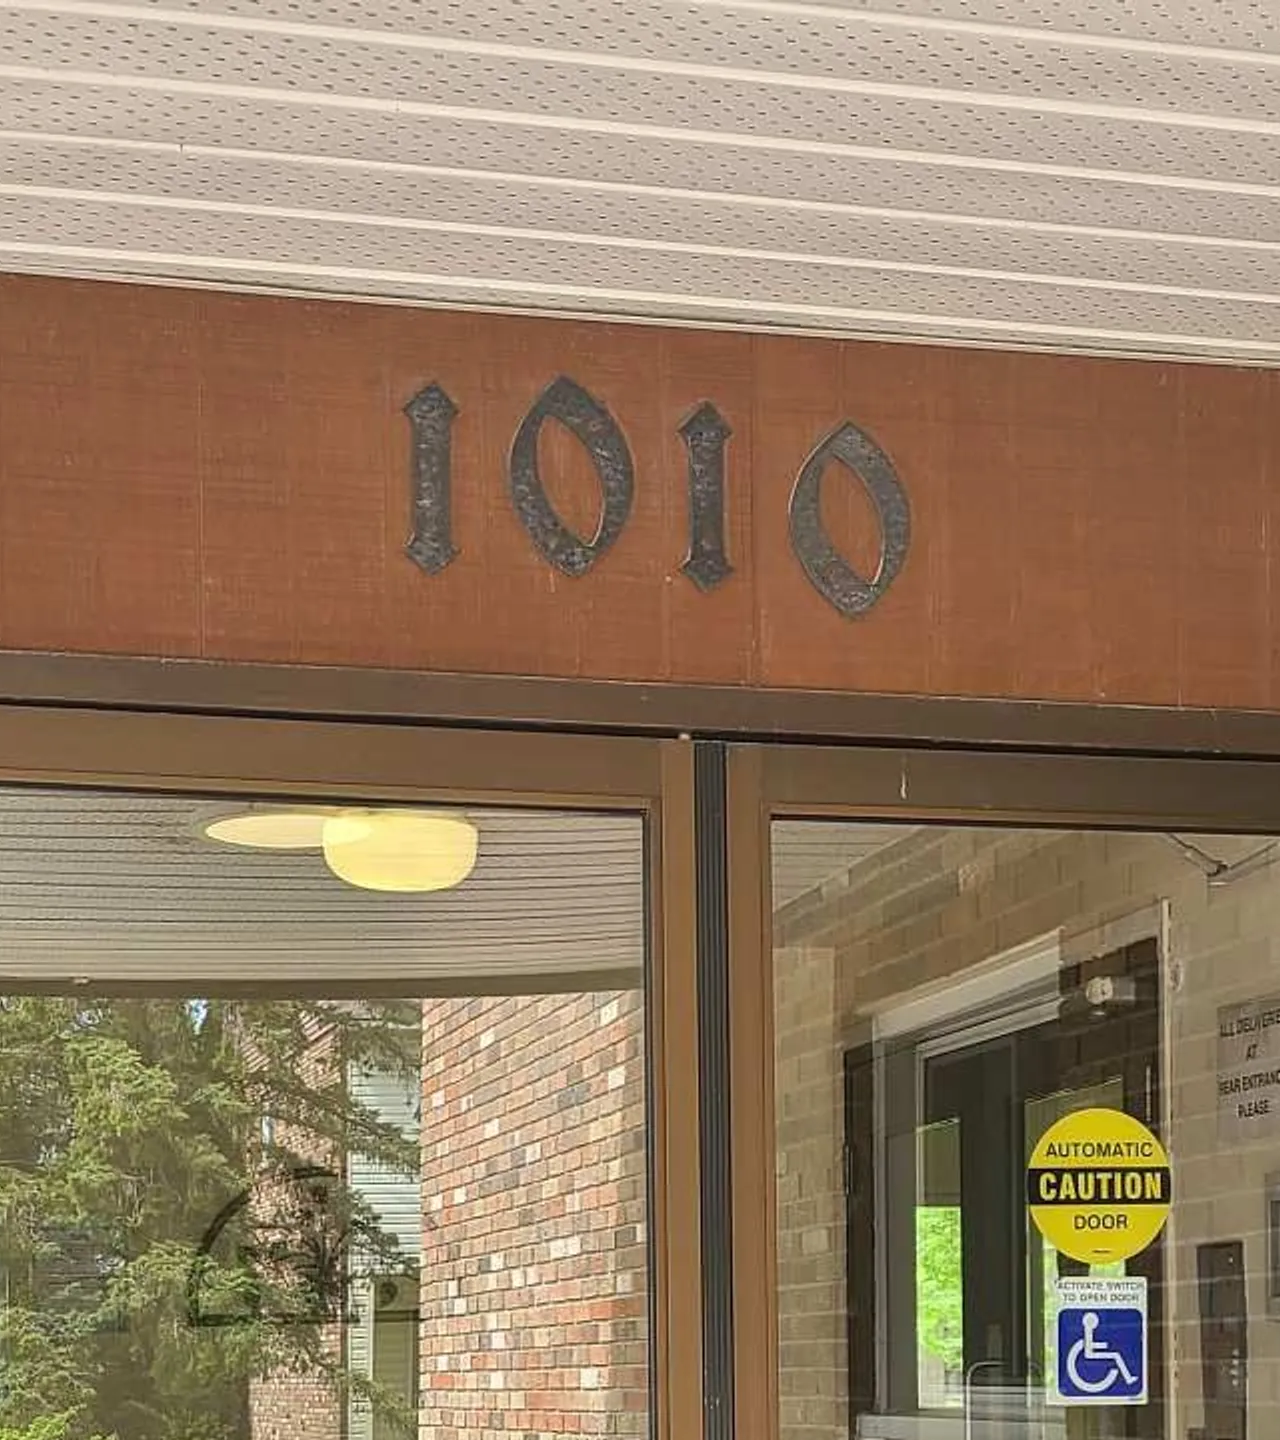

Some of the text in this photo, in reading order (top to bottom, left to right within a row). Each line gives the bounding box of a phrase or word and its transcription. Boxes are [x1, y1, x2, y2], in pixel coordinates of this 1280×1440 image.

[403, 376, 911, 622] 1010
[1246, 1043, 1258, 1061] AT
[1238, 1099, 1272, 1118] PLEASE
[1045, 1142, 1153, 1158] AUTOMATIC
[1038, 1171, 1162, 1200] CAUTION
[1073, 1214, 1128, 1230] DOOR
[1056, 1282, 1144, 1290] ACTIVATE SWITCH
